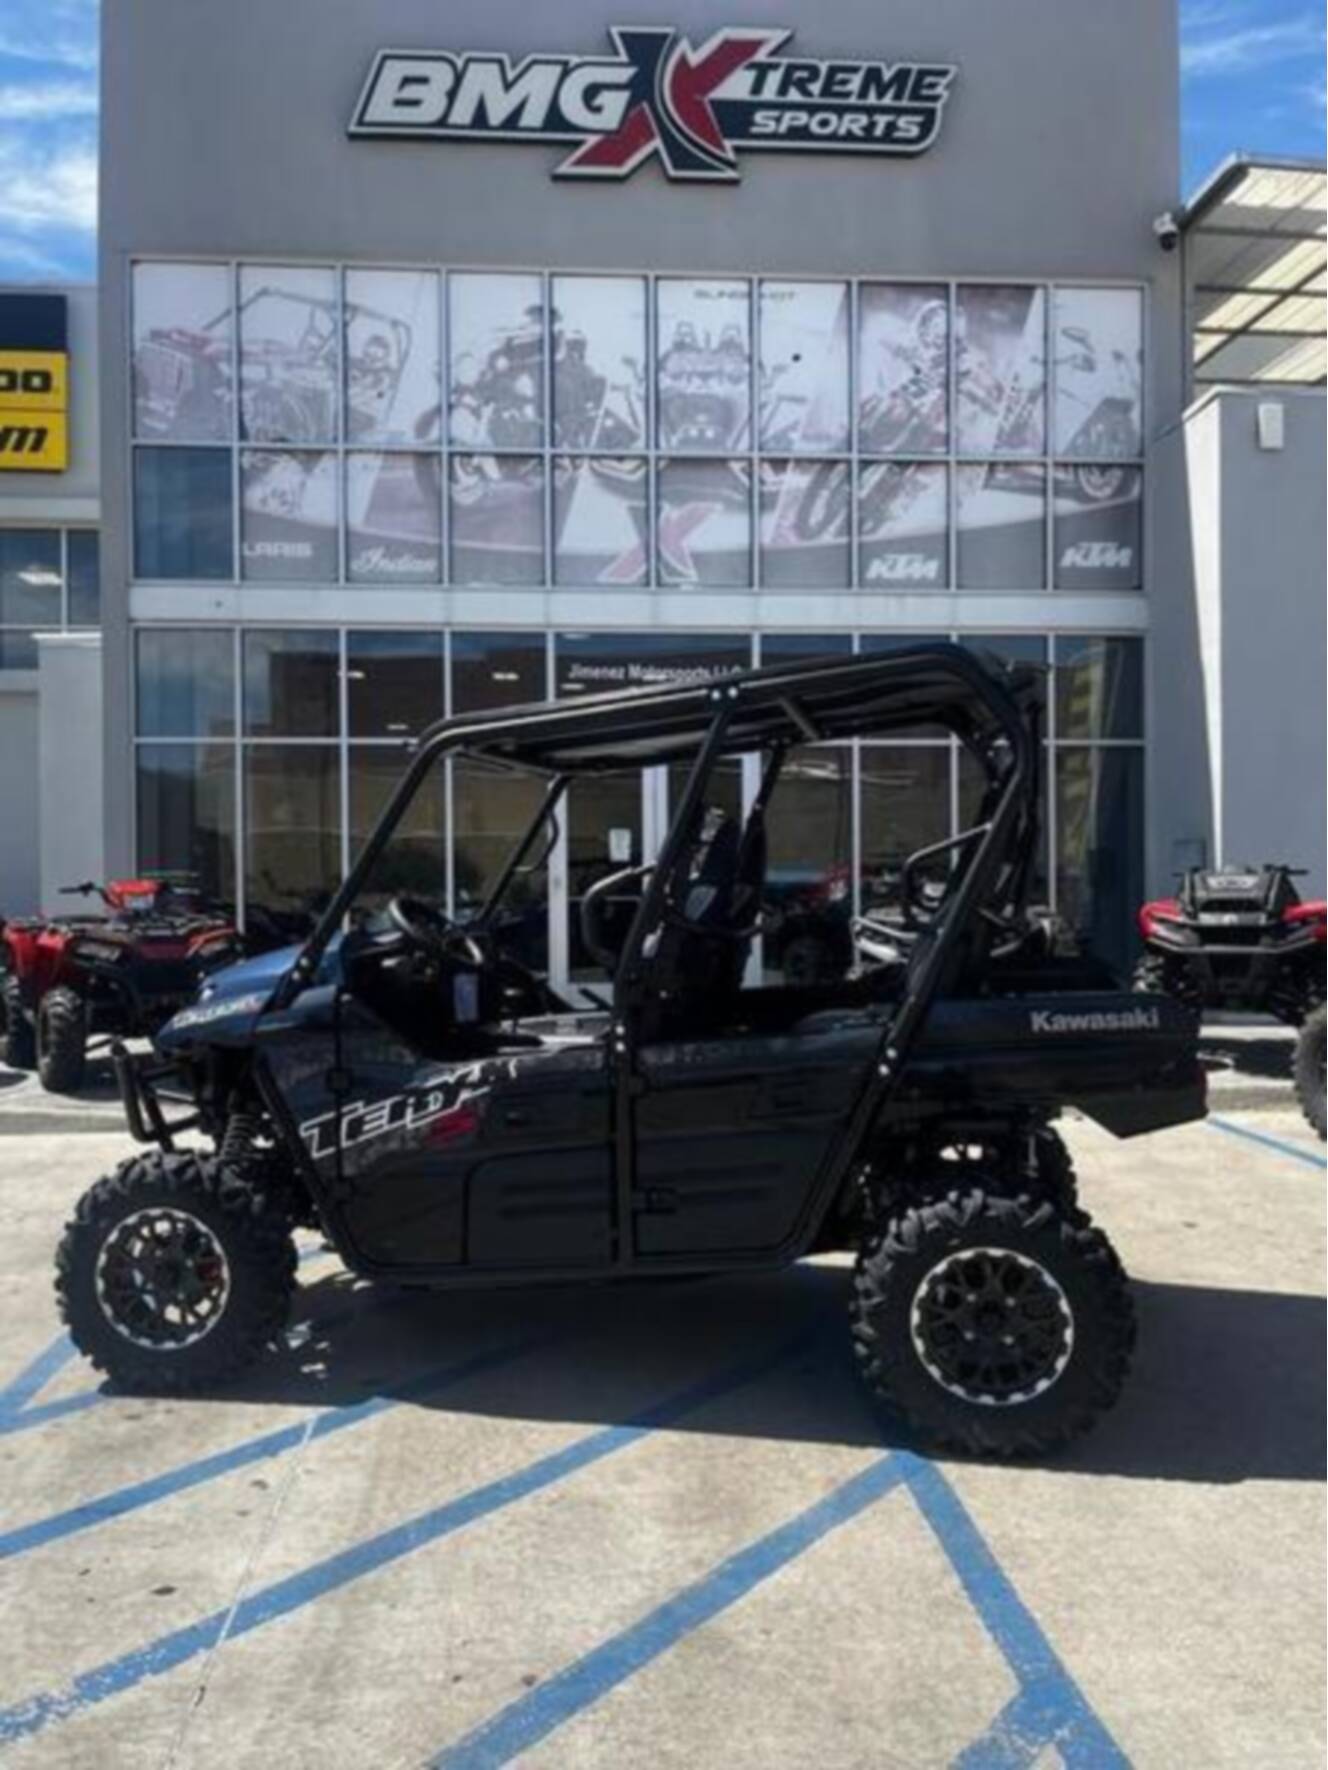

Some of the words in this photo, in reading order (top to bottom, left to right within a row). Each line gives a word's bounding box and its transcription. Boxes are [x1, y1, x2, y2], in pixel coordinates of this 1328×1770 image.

[361, 61, 640, 130] BMG
[749, 109, 925, 138] SPORTS
[865, 553, 940, 580] KTM
[1059, 541, 1134, 568] KTM
[1030, 1007, 1160, 1033] Kawasaki
